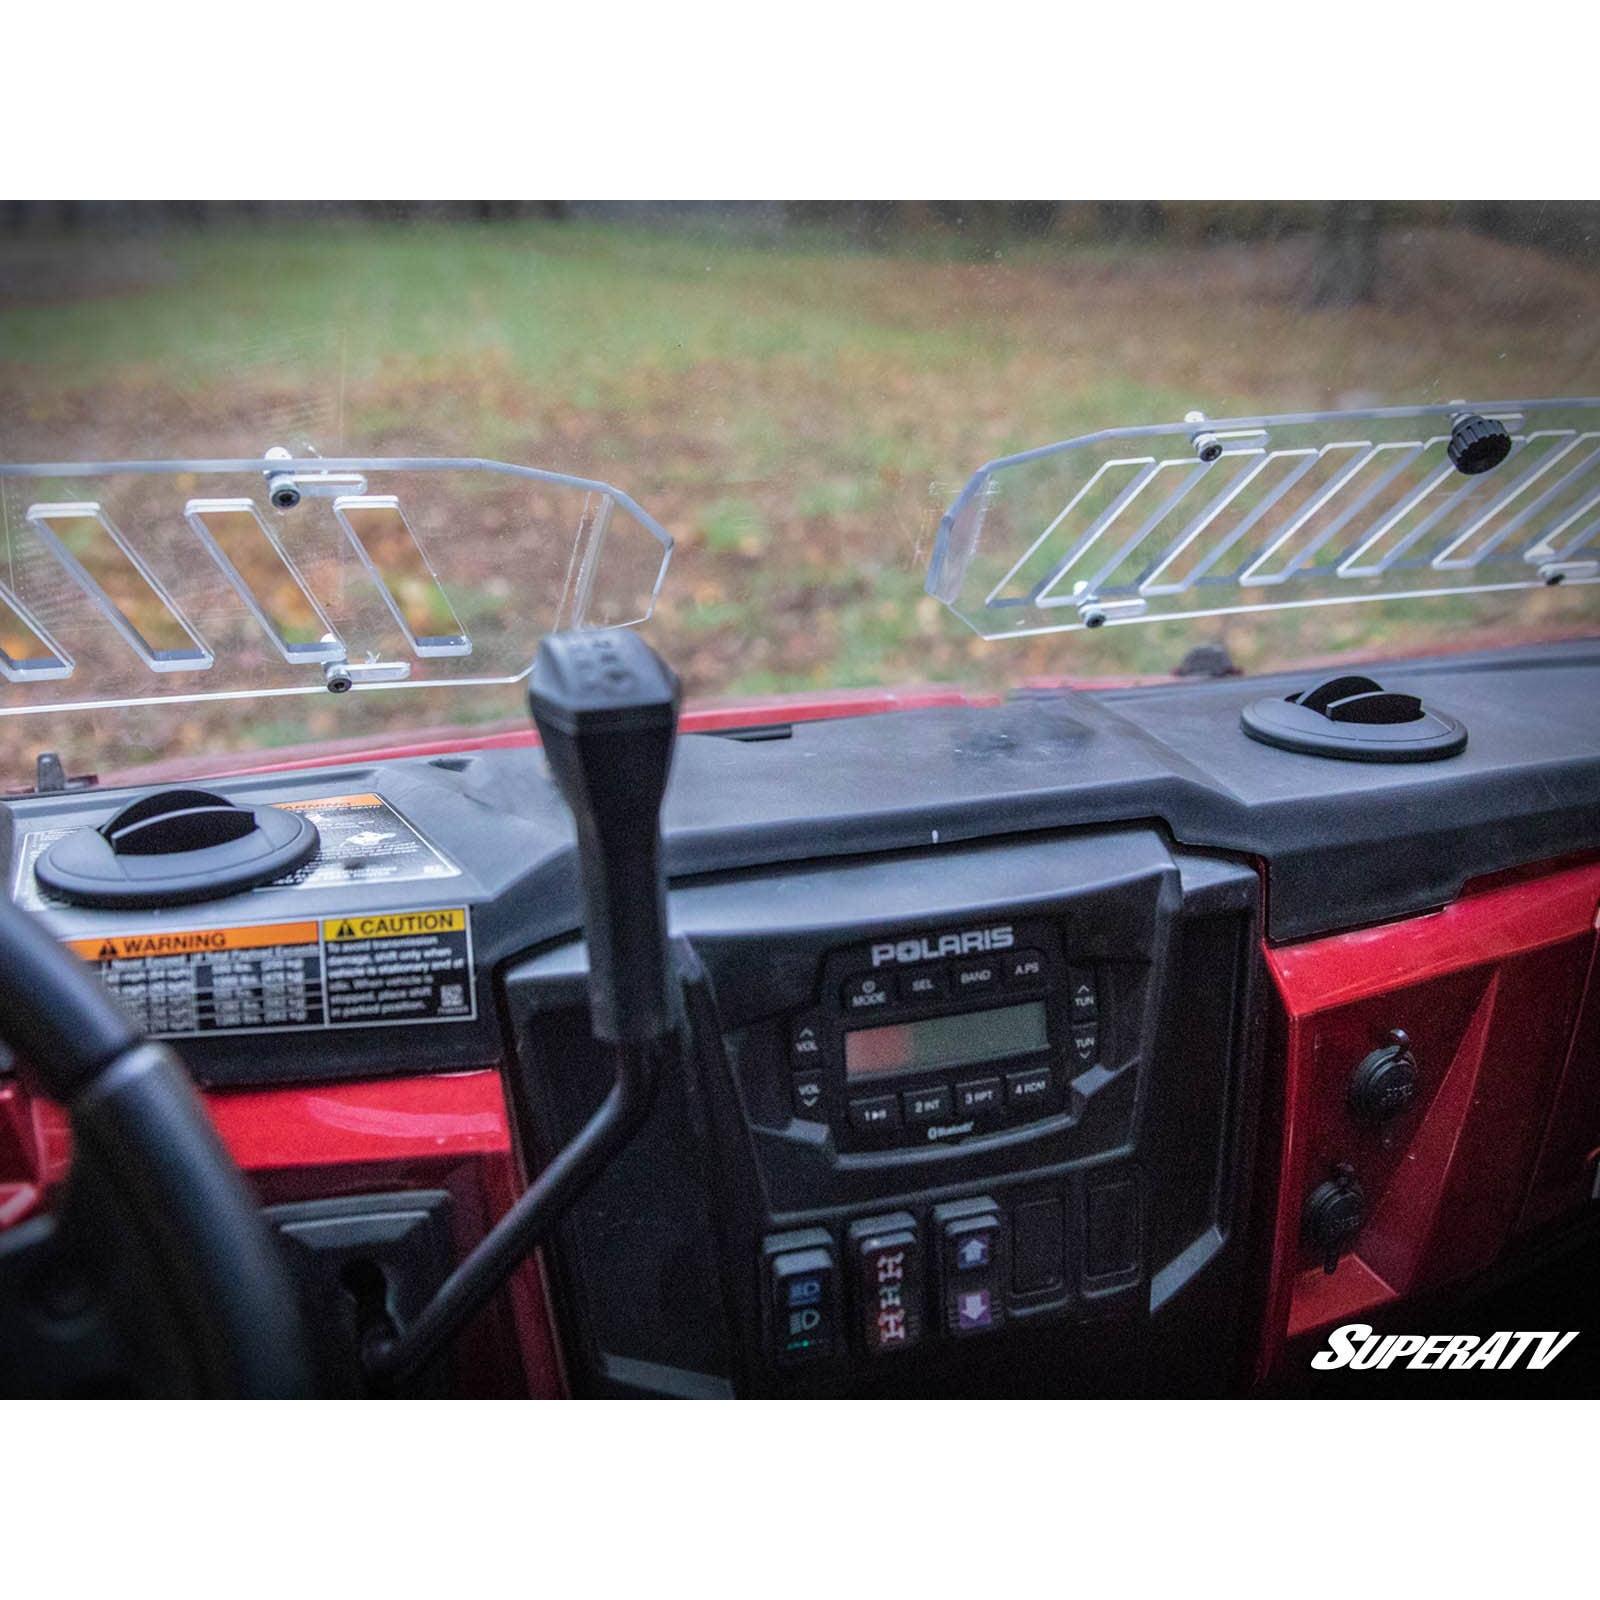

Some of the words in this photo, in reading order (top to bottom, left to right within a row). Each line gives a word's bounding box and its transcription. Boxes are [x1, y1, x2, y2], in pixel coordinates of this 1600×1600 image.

[360, 913, 453, 935] CAUTION
[123, 932, 227, 954] WARNING
[871, 926, 1015, 967] POLARIS
[960, 969, 992, 984] BAND
[912, 978, 934, 992] SEL
[853, 991, 887, 1008] MODE
[1074, 995, 1094, 1007] TUN
[795, 1040, 819, 1052] VOL
[1074, 1037, 1095, 1049] TUN
[799, 1083, 820, 1096] VOL
[915, 1102, 923, 1113] 2
